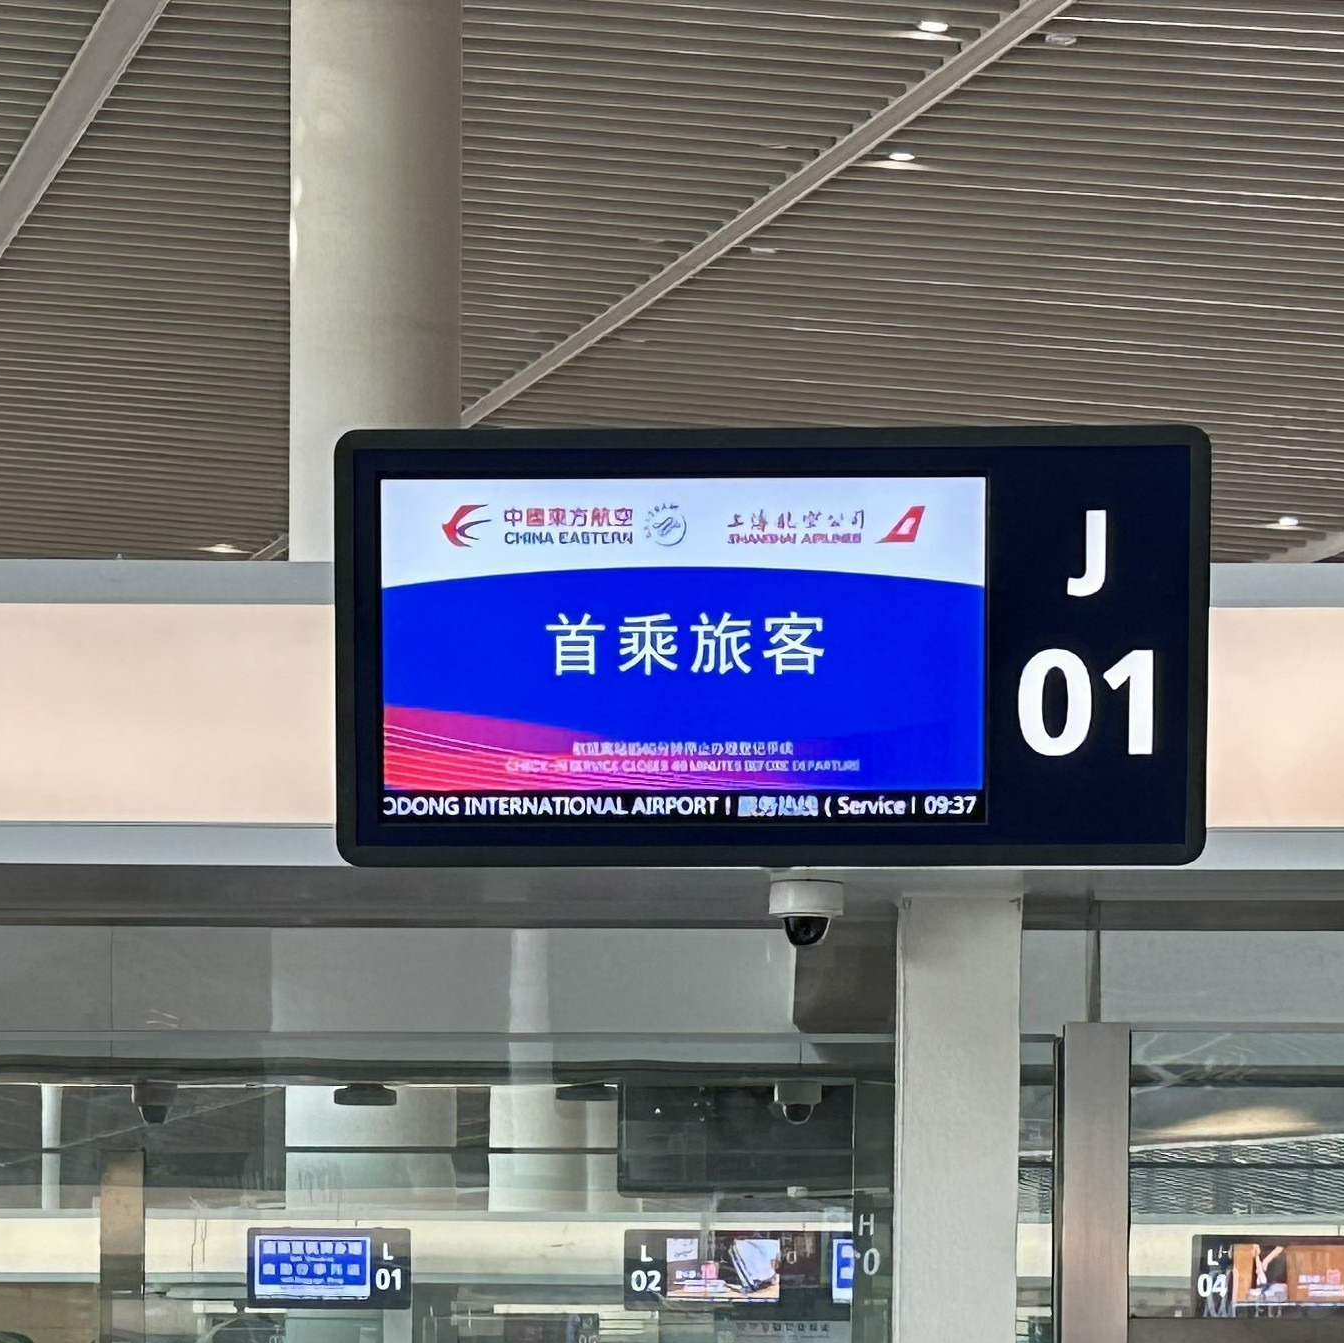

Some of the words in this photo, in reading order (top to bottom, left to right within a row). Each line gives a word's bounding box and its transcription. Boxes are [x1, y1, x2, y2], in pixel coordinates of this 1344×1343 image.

[504, 531, 554, 545] CHINA
[1067, 509, 1107, 597] J
[545, 611, 825, 676] 首乘旅客
[1018, 647, 1155, 757] 01
[465, 796, 628, 815] INTERNATIONAL
[631, 796, 719, 815] AIRPORT
[838, 796, 906, 815] Service
[924, 796, 976, 814] 09:37
[383, 1242, 394, 1261] L
[640, 1244, 653, 1262] L
[1207, 1249, 1218, 1266] L
[375, 1268, 402, 1290] 01
[630, 1270, 662, 1292] 02
[1197, 1273, 1228, 1298] 04
